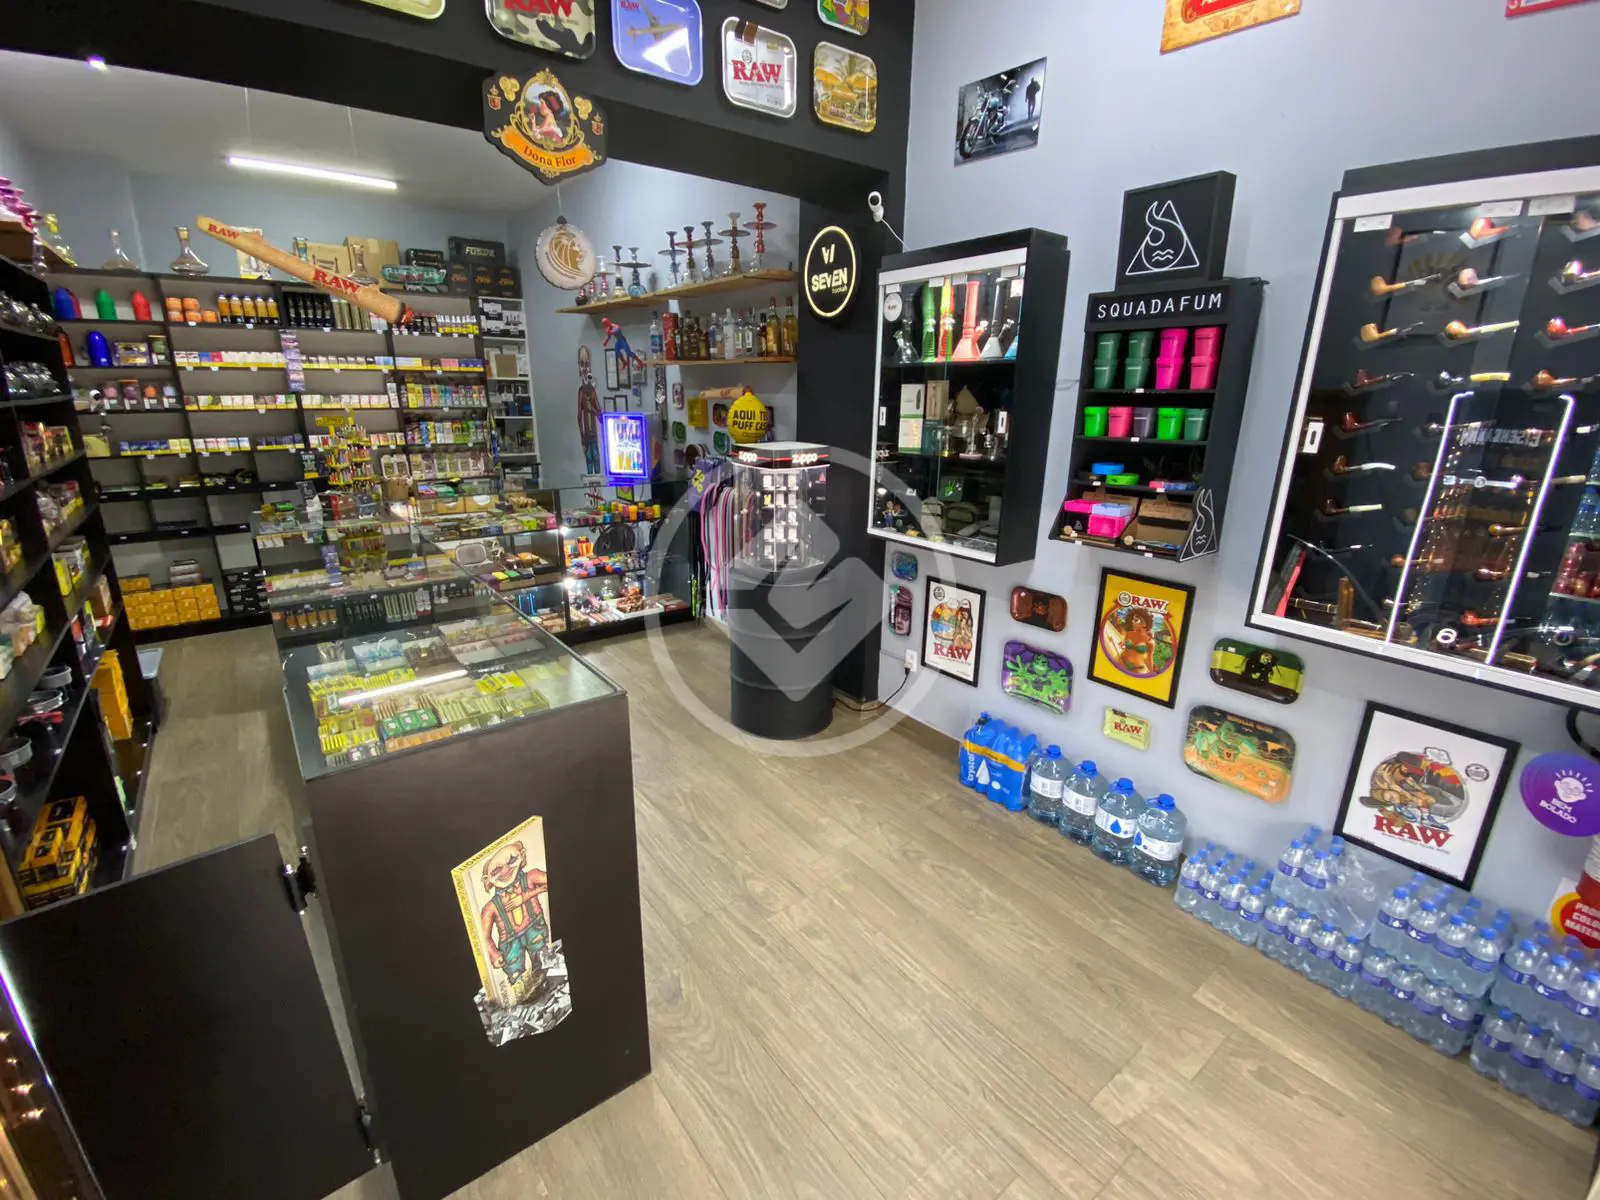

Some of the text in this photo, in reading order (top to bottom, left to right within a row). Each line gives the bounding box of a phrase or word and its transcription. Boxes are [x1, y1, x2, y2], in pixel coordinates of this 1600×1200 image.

[620, 1, 640, 10] RAW
[731, 59, 782, 84] RAW
[522, 146, 576, 167] Dona Flor
[207, 223, 240, 240] RAW
[313, 268, 361, 293] RAW
[1097, 292, 1222, 319] SQUADAFUM
[733, 410, 756, 421] AQUI
[732, 420, 754, 430] PUFF
[792, 452, 818, 465] zippo
[1131, 595, 1167, 610] RAW
[933, 642, 972, 661] RAW
[1114, 721, 1142, 735] RAW
[1539, 799, 1578, 824] BOLADO
[1551, 797, 1573, 814] BEM
[1373, 813, 1453, 848] RAW
